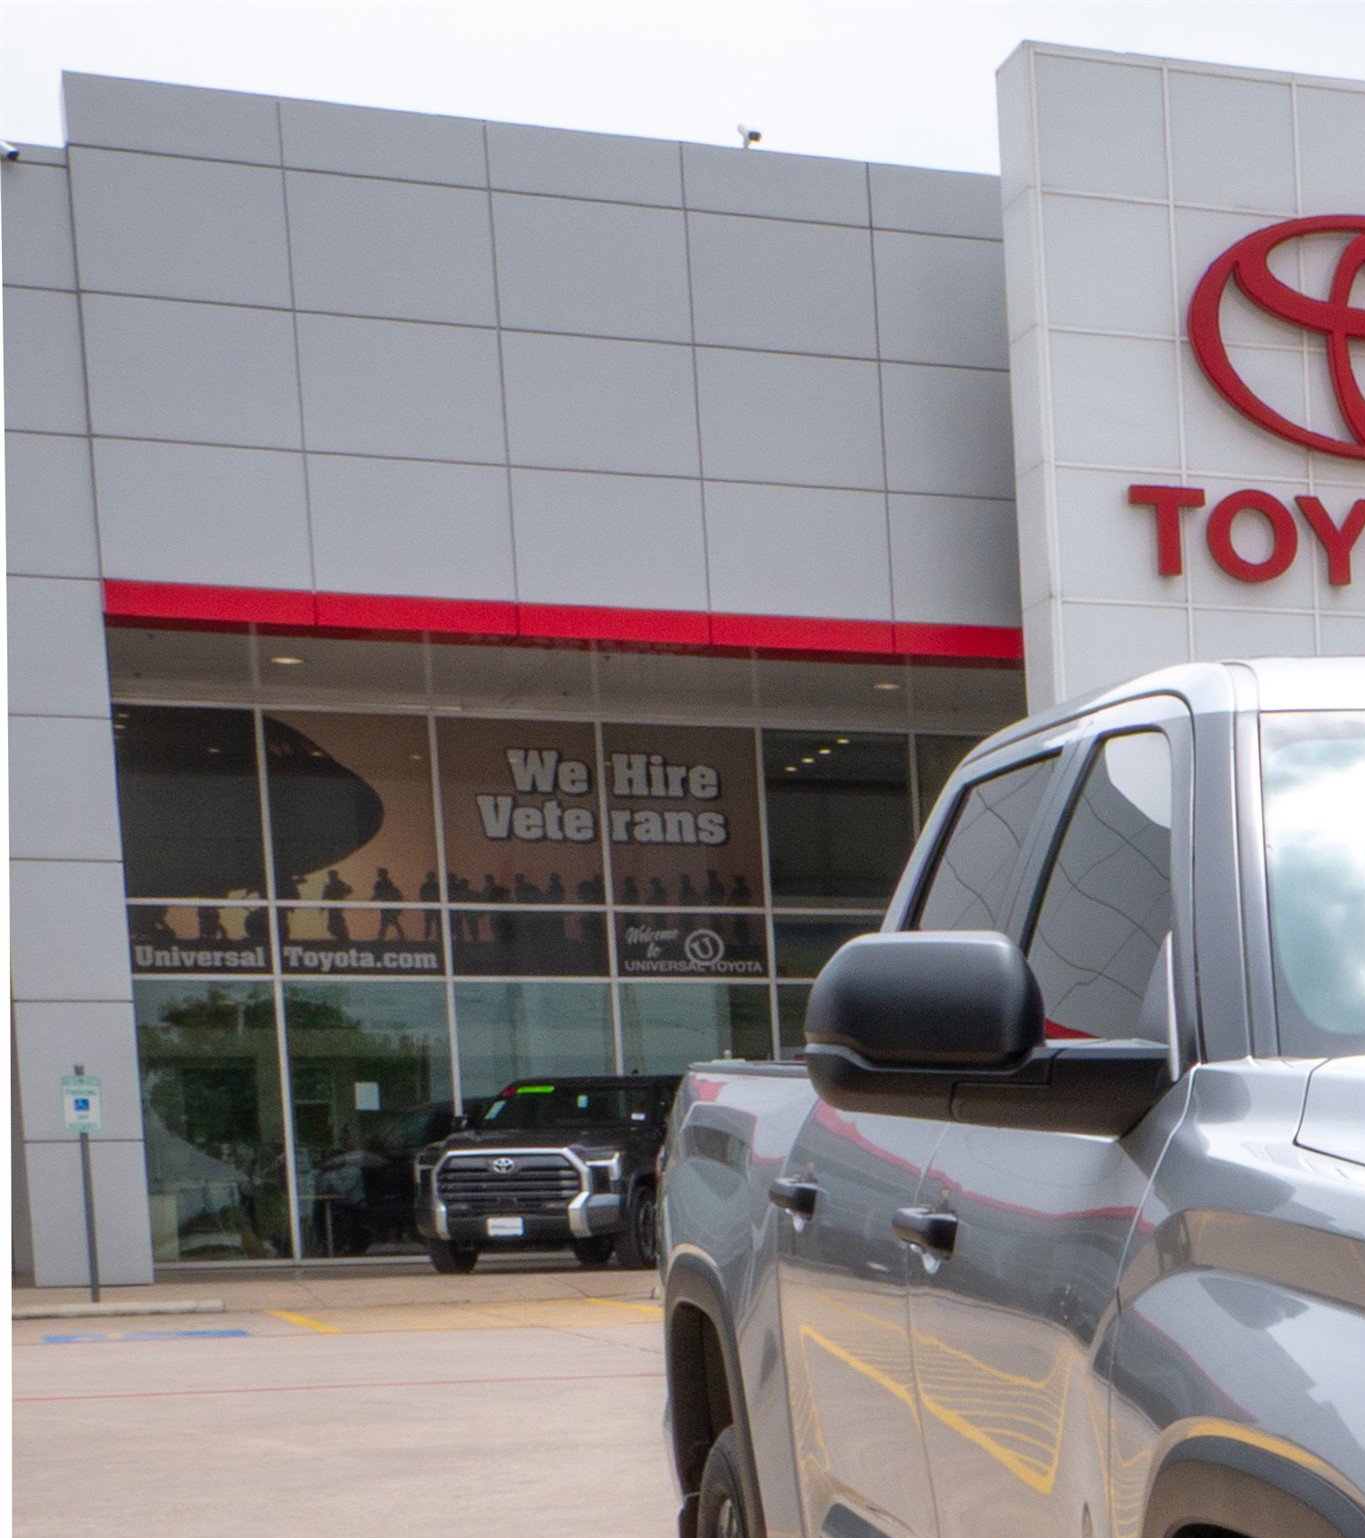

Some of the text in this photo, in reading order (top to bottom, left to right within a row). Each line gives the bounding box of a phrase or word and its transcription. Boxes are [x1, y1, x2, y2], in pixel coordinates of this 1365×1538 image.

[506, 748, 720, 800] We Hire
[475, 794, 729, 844] Veterans
[135, 946, 439, 973] Universal Toyota.com
[624, 960, 763, 973] UNIVERSAL TOYOTA
